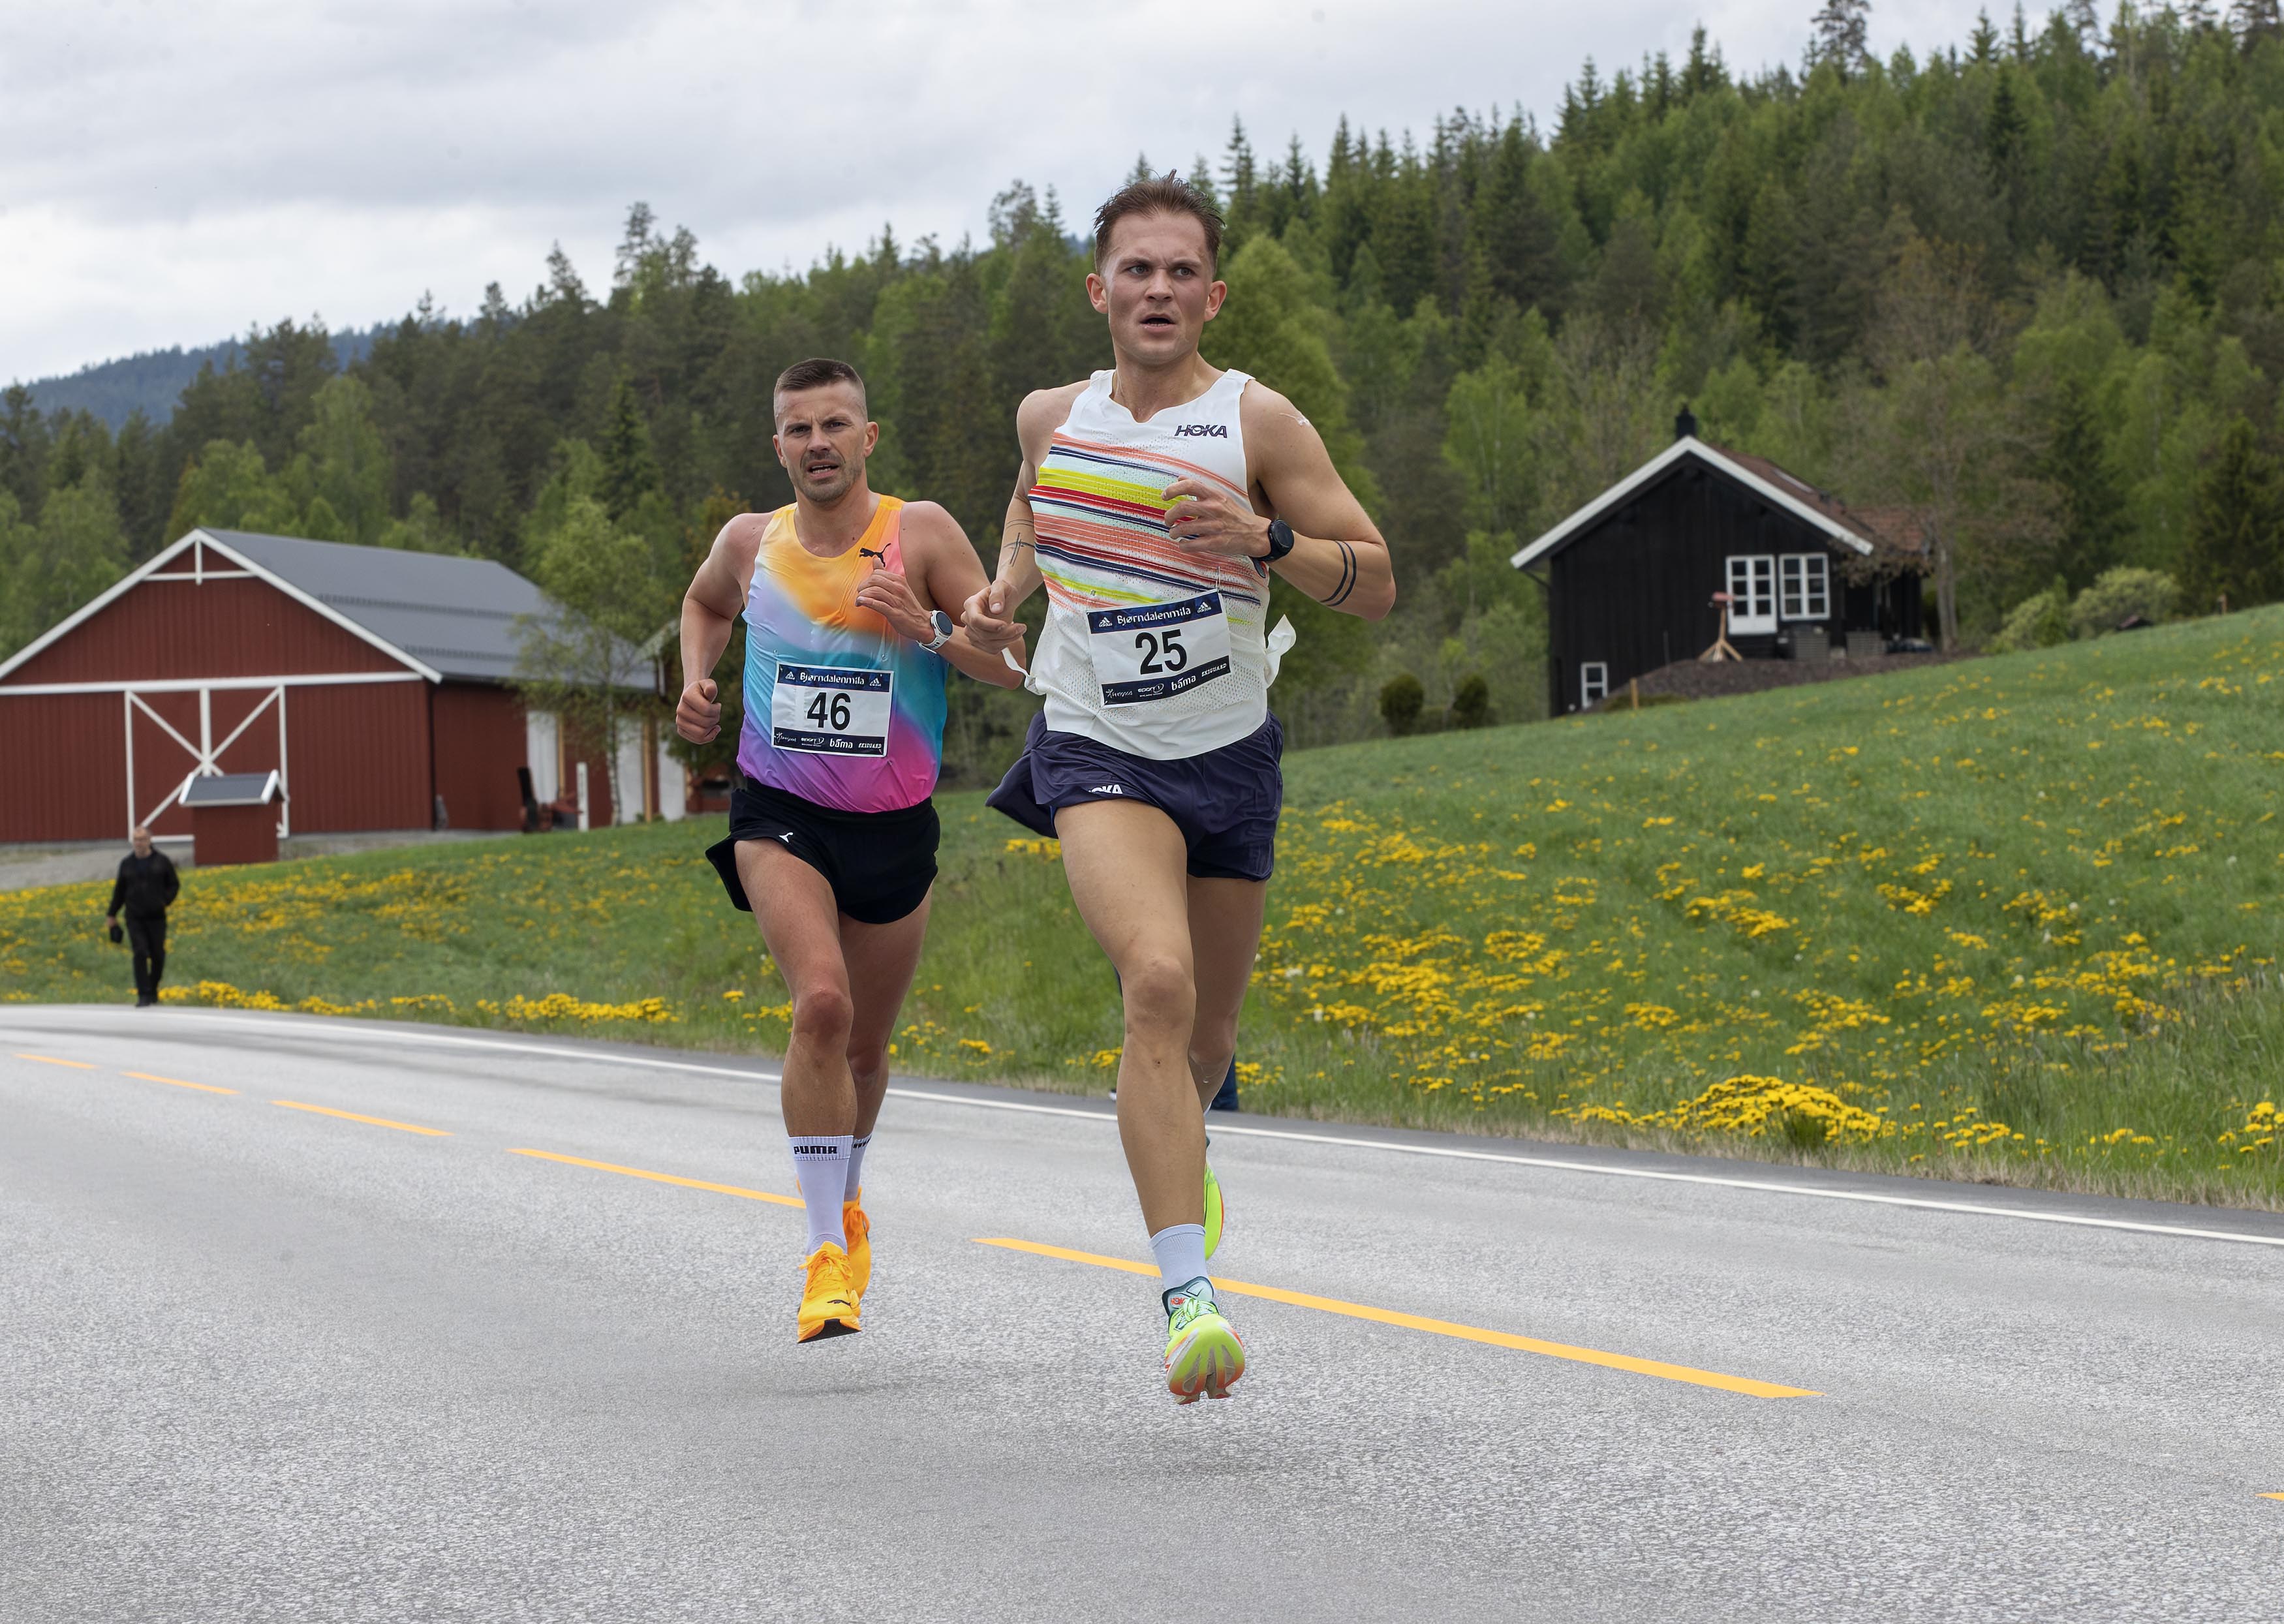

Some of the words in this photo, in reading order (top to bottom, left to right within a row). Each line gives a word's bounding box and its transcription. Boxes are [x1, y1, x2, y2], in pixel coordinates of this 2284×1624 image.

[1175, 424, 1227, 438] HOKA
[1117, 606, 1191, 626] Bjørndalenmila
[1135, 628, 1187, 675] 25
[799, 671, 865, 685] Bjørndalenmila
[807, 692, 851, 731] 46
[794, 1145, 838, 1155] PUMA
